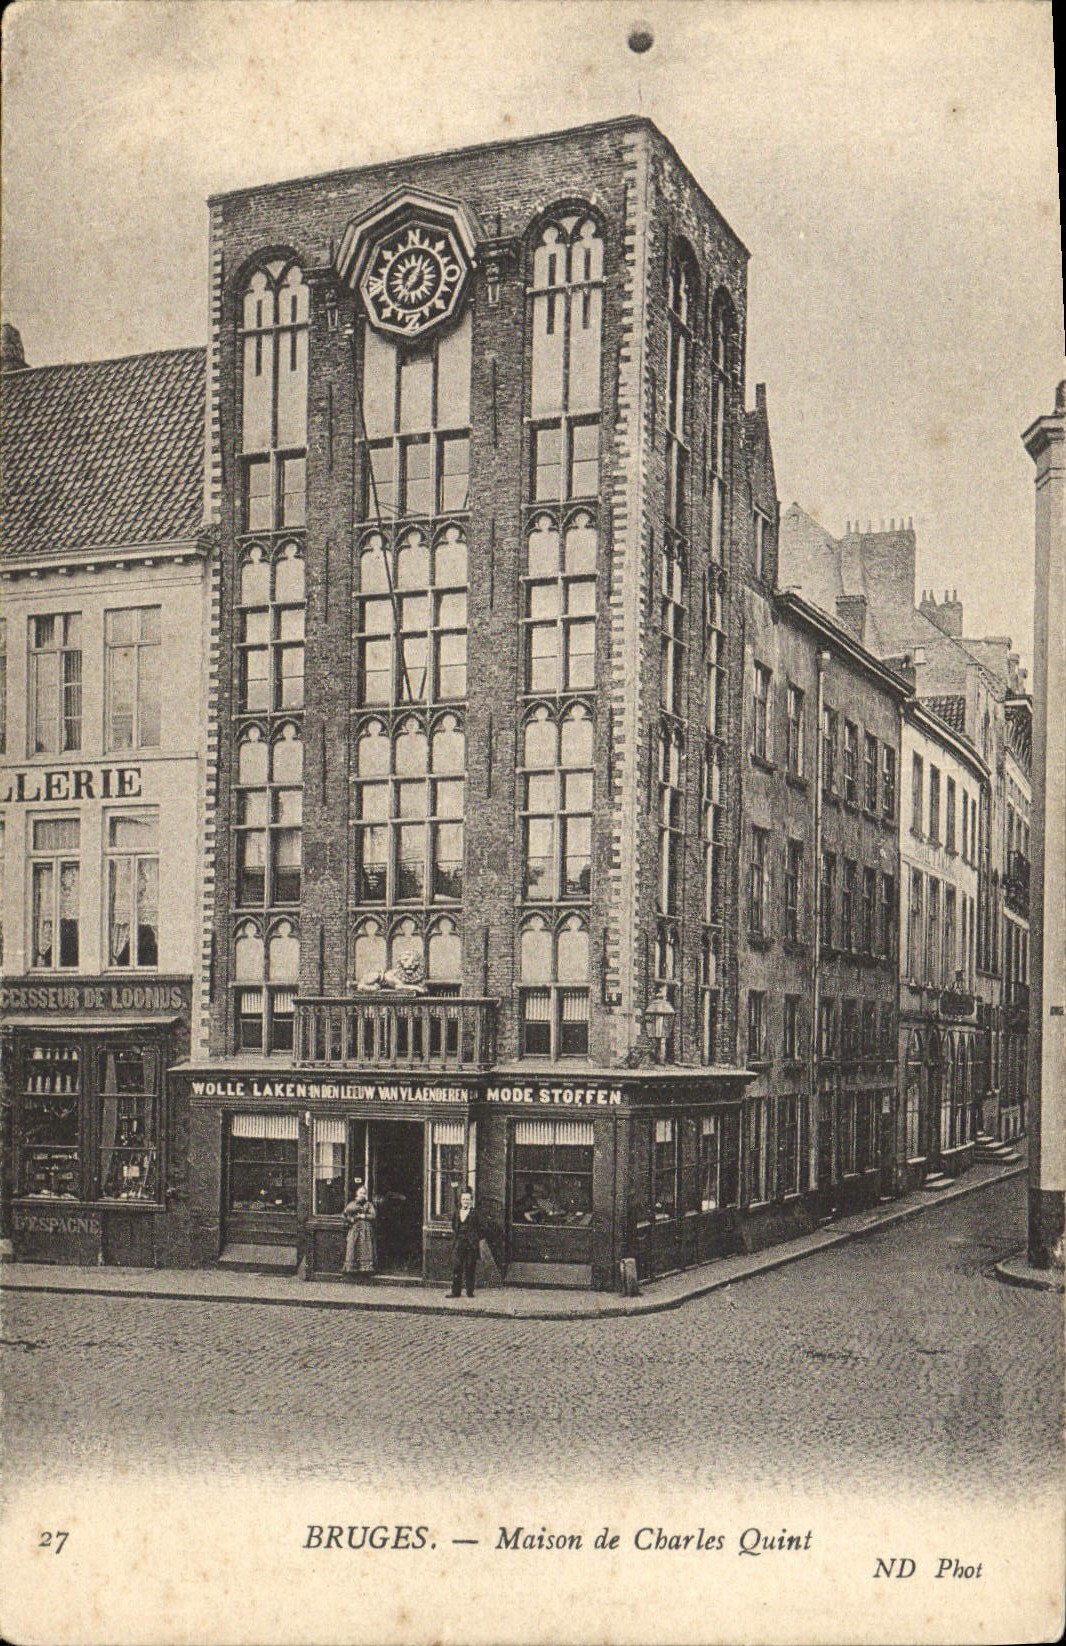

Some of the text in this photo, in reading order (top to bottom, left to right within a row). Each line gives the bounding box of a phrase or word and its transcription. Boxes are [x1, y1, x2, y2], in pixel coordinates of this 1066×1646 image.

[407, 228, 421, 247] N
[444, 264, 460, 282] O
[84, 987, 105, 1008] DE
[191, 1082, 306, 1098] WOLLE LAKEN
[340, 1085, 375, 1100] LEEUW
[377, 1086, 399, 1101] VAN
[399, 1086, 469, 1103] VLAENDEREN
[486, 1087, 534, 1103] MODE
[539, 1088, 622, 1105] STOFFEN
